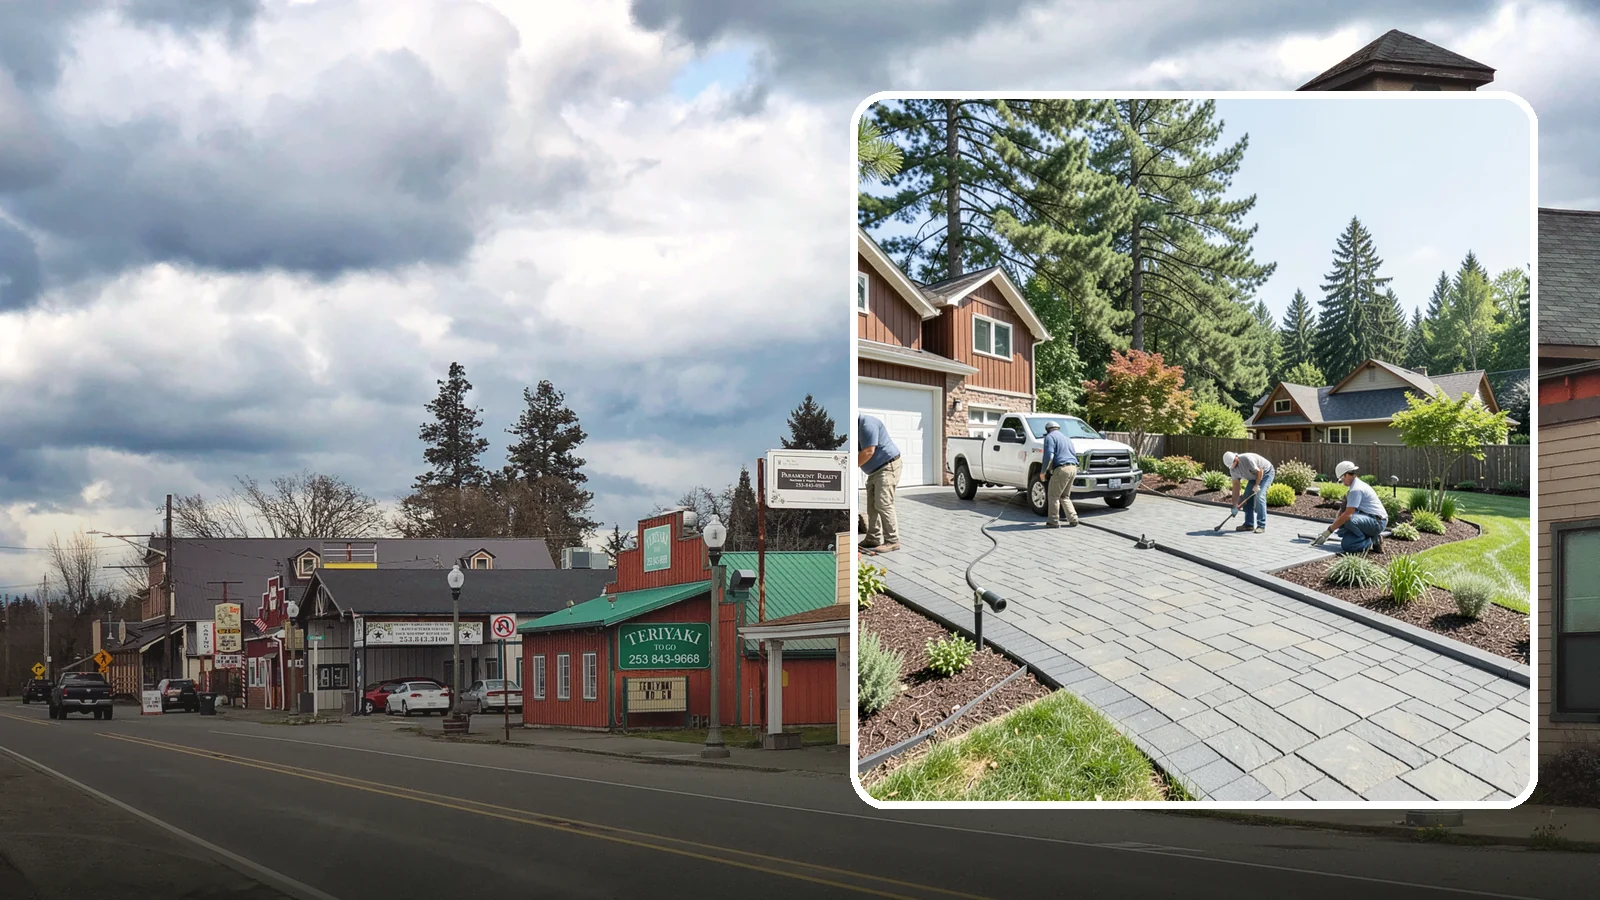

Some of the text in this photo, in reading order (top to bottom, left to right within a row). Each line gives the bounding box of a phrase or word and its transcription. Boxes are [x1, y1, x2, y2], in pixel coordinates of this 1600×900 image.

[625, 628, 702, 646] TERIYAKI
[628, 654, 700, 664] 253 843-9668
